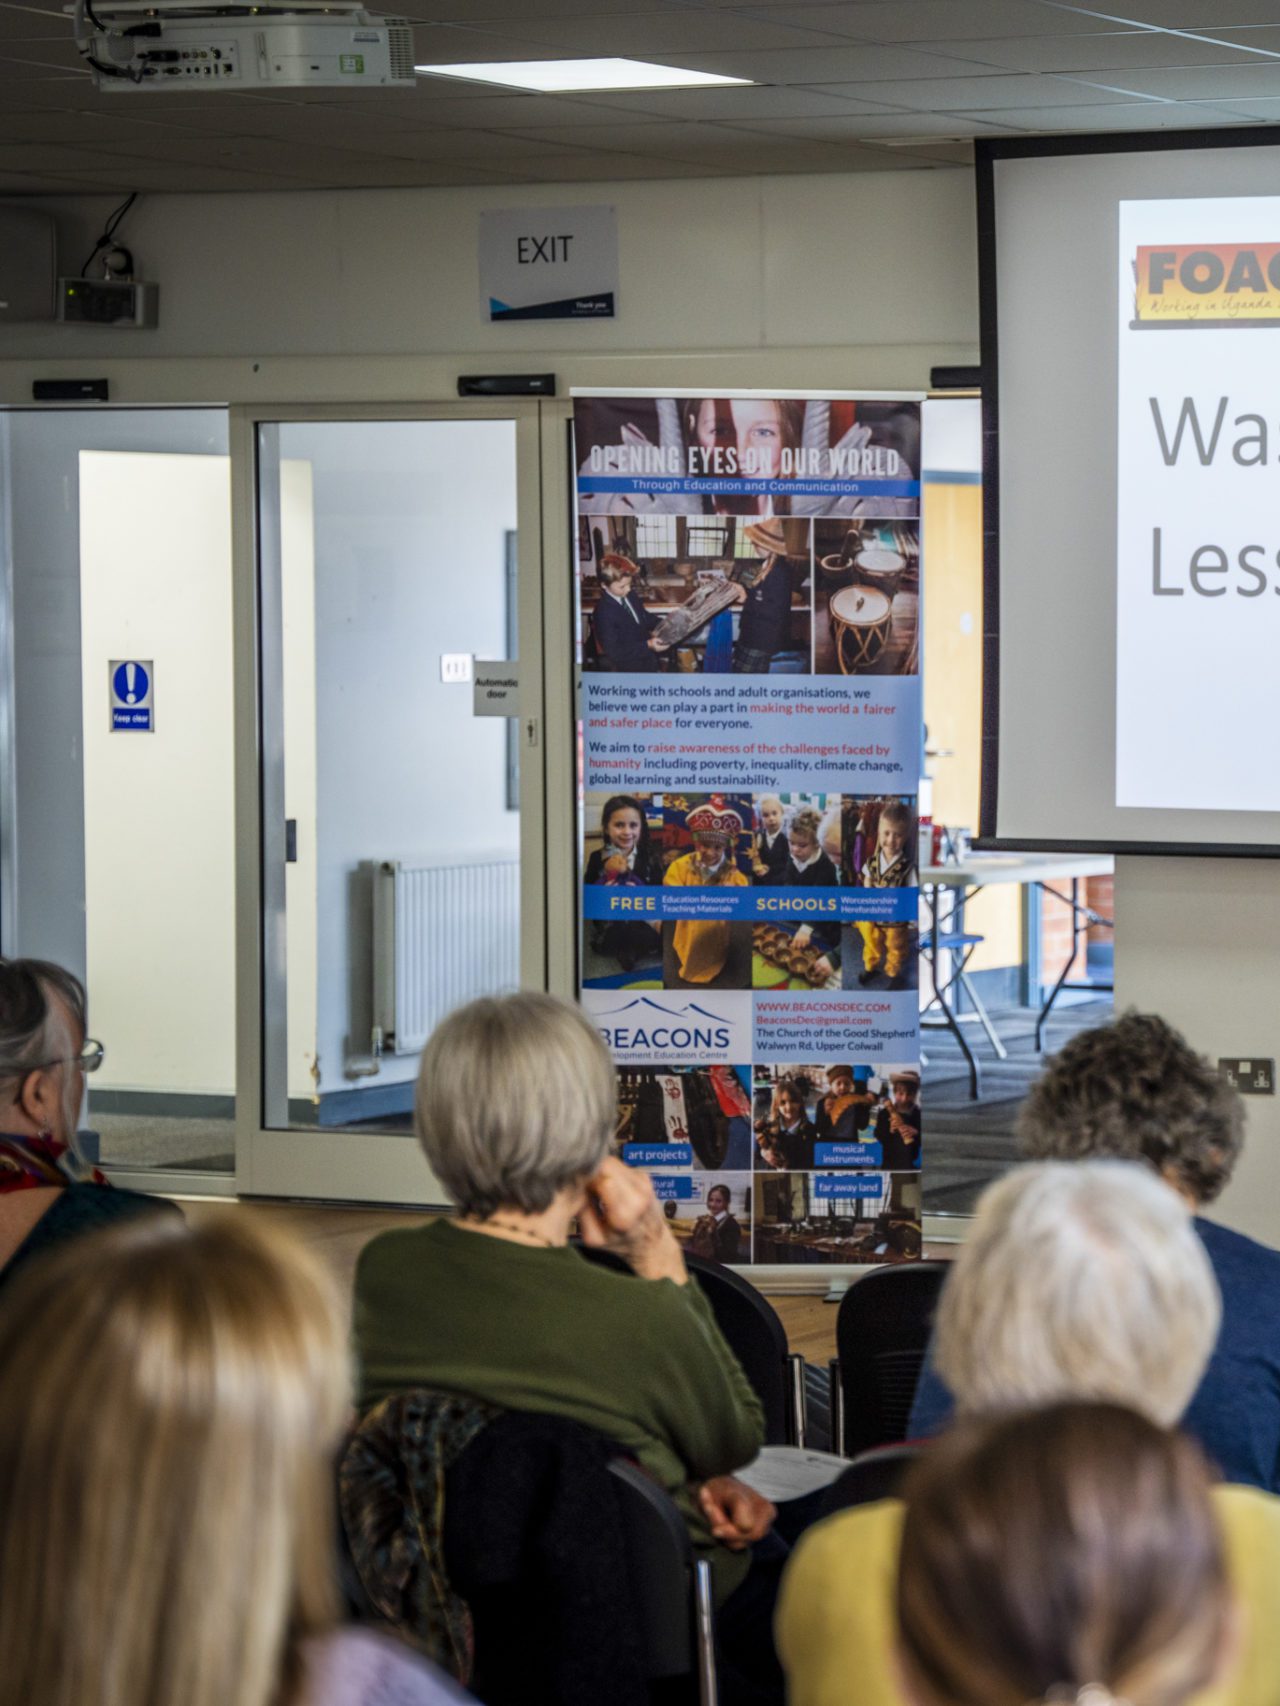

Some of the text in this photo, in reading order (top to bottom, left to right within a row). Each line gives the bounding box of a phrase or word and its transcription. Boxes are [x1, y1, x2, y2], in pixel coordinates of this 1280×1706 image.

[517, 235, 574, 264] EXIT
[1150, 299, 1201, 320] Working
[1204, 299, 1217, 311] in
[1222, 296, 1274, 320] Uganda
[590, 445, 900, 477] OPENING EYES ON OUR WORLD
[632, 480, 859, 492] Through Education and Communication
[474, 678, 519, 688] Automatic
[486, 690, 507, 699] door
[588, 685, 637, 698] Working
[638, 685, 665, 697] with
[668, 686, 711, 697] schools
[714, 686, 735, 697] and
[738, 687, 768, 698] adult
[770, 687, 852, 700] organisations,
[853, 689, 871, 699] we
[588, 701, 897, 716] believe we can play a part in making the world a fairer
[588, 717, 753, 731] and safer place for everyone.
[588, 742, 890, 757] We aim to raise awareness of the challenges faced by
[588, 758, 904, 773] humanity including poverty, inequality, climate change,
[588, 773, 780, 788] global learning and sustainability.
[610, 897, 656, 911] FREE
[661, 895, 739, 905] Education Resources
[756, 898, 837, 912] SCHOOLS
[662, 905, 733, 914] Teaching Materials
[756, 1002, 892, 1014] WWW.BEACONSDEC.COM
[756, 1028, 916, 1041] The Church of the Good Shepherd
[756, 1041, 797, 1052] Walwyn
[815, 1041, 846, 1052] Upper
[847, 1041, 884, 1052] Colwall
[653, 1051, 697, 1060] Education
[698, 1051, 728, 1060] Centre
[627, 1149, 689, 1162] art projects
[832, 1144, 866, 1154] musical
[823, 1155, 876, 1164] instruments
[818, 1183, 879, 1194] far away land
